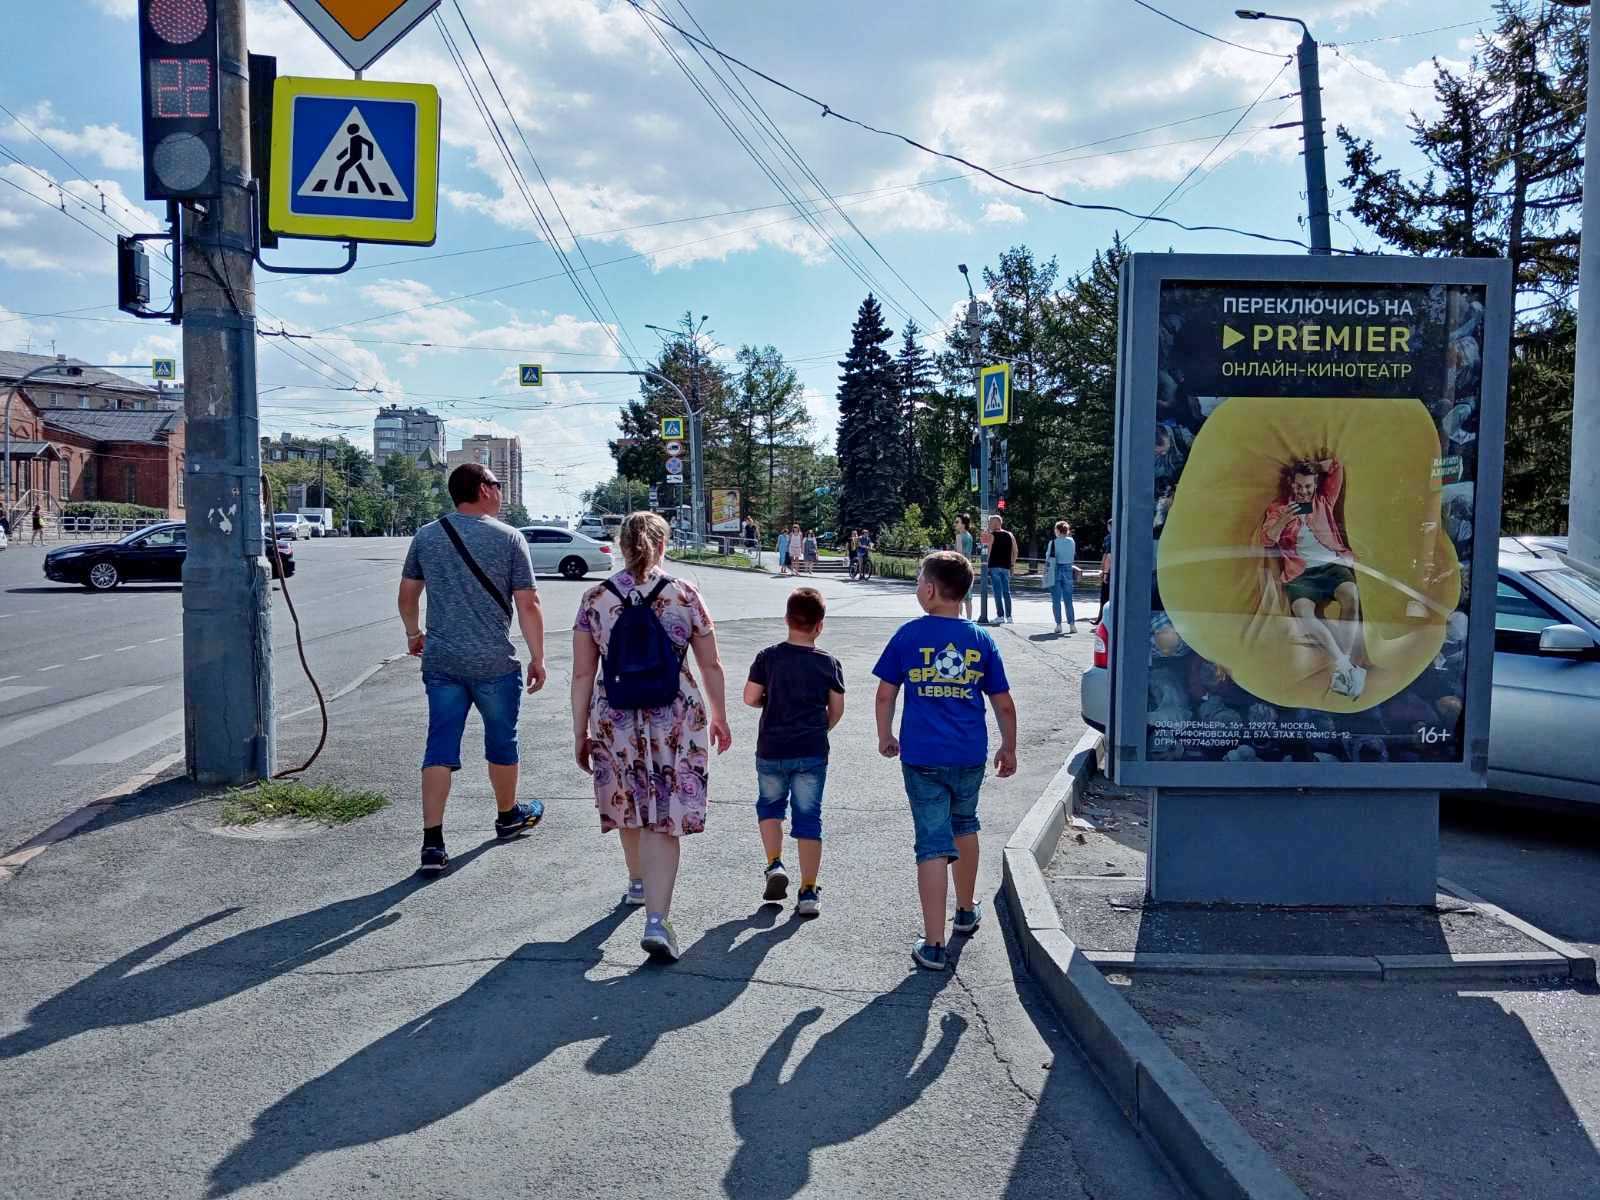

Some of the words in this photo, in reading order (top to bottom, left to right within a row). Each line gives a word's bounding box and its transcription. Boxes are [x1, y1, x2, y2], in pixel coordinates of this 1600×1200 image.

[158, 58, 210, 117] 22
[1223, 297, 1379, 315] ПЕРЕКЛЮЧИСЬ
[1384, 299, 1414, 315] НА
[1253, 324, 1411, 352] PREMIER
[1221, 358, 1413, 379] ОНЛАЙН-КИНОТЕАТР
[919, 647, 982, 667] TP
[918, 686, 974, 699] LEBBEK
[1417, 726, 1451, 744] 16+
